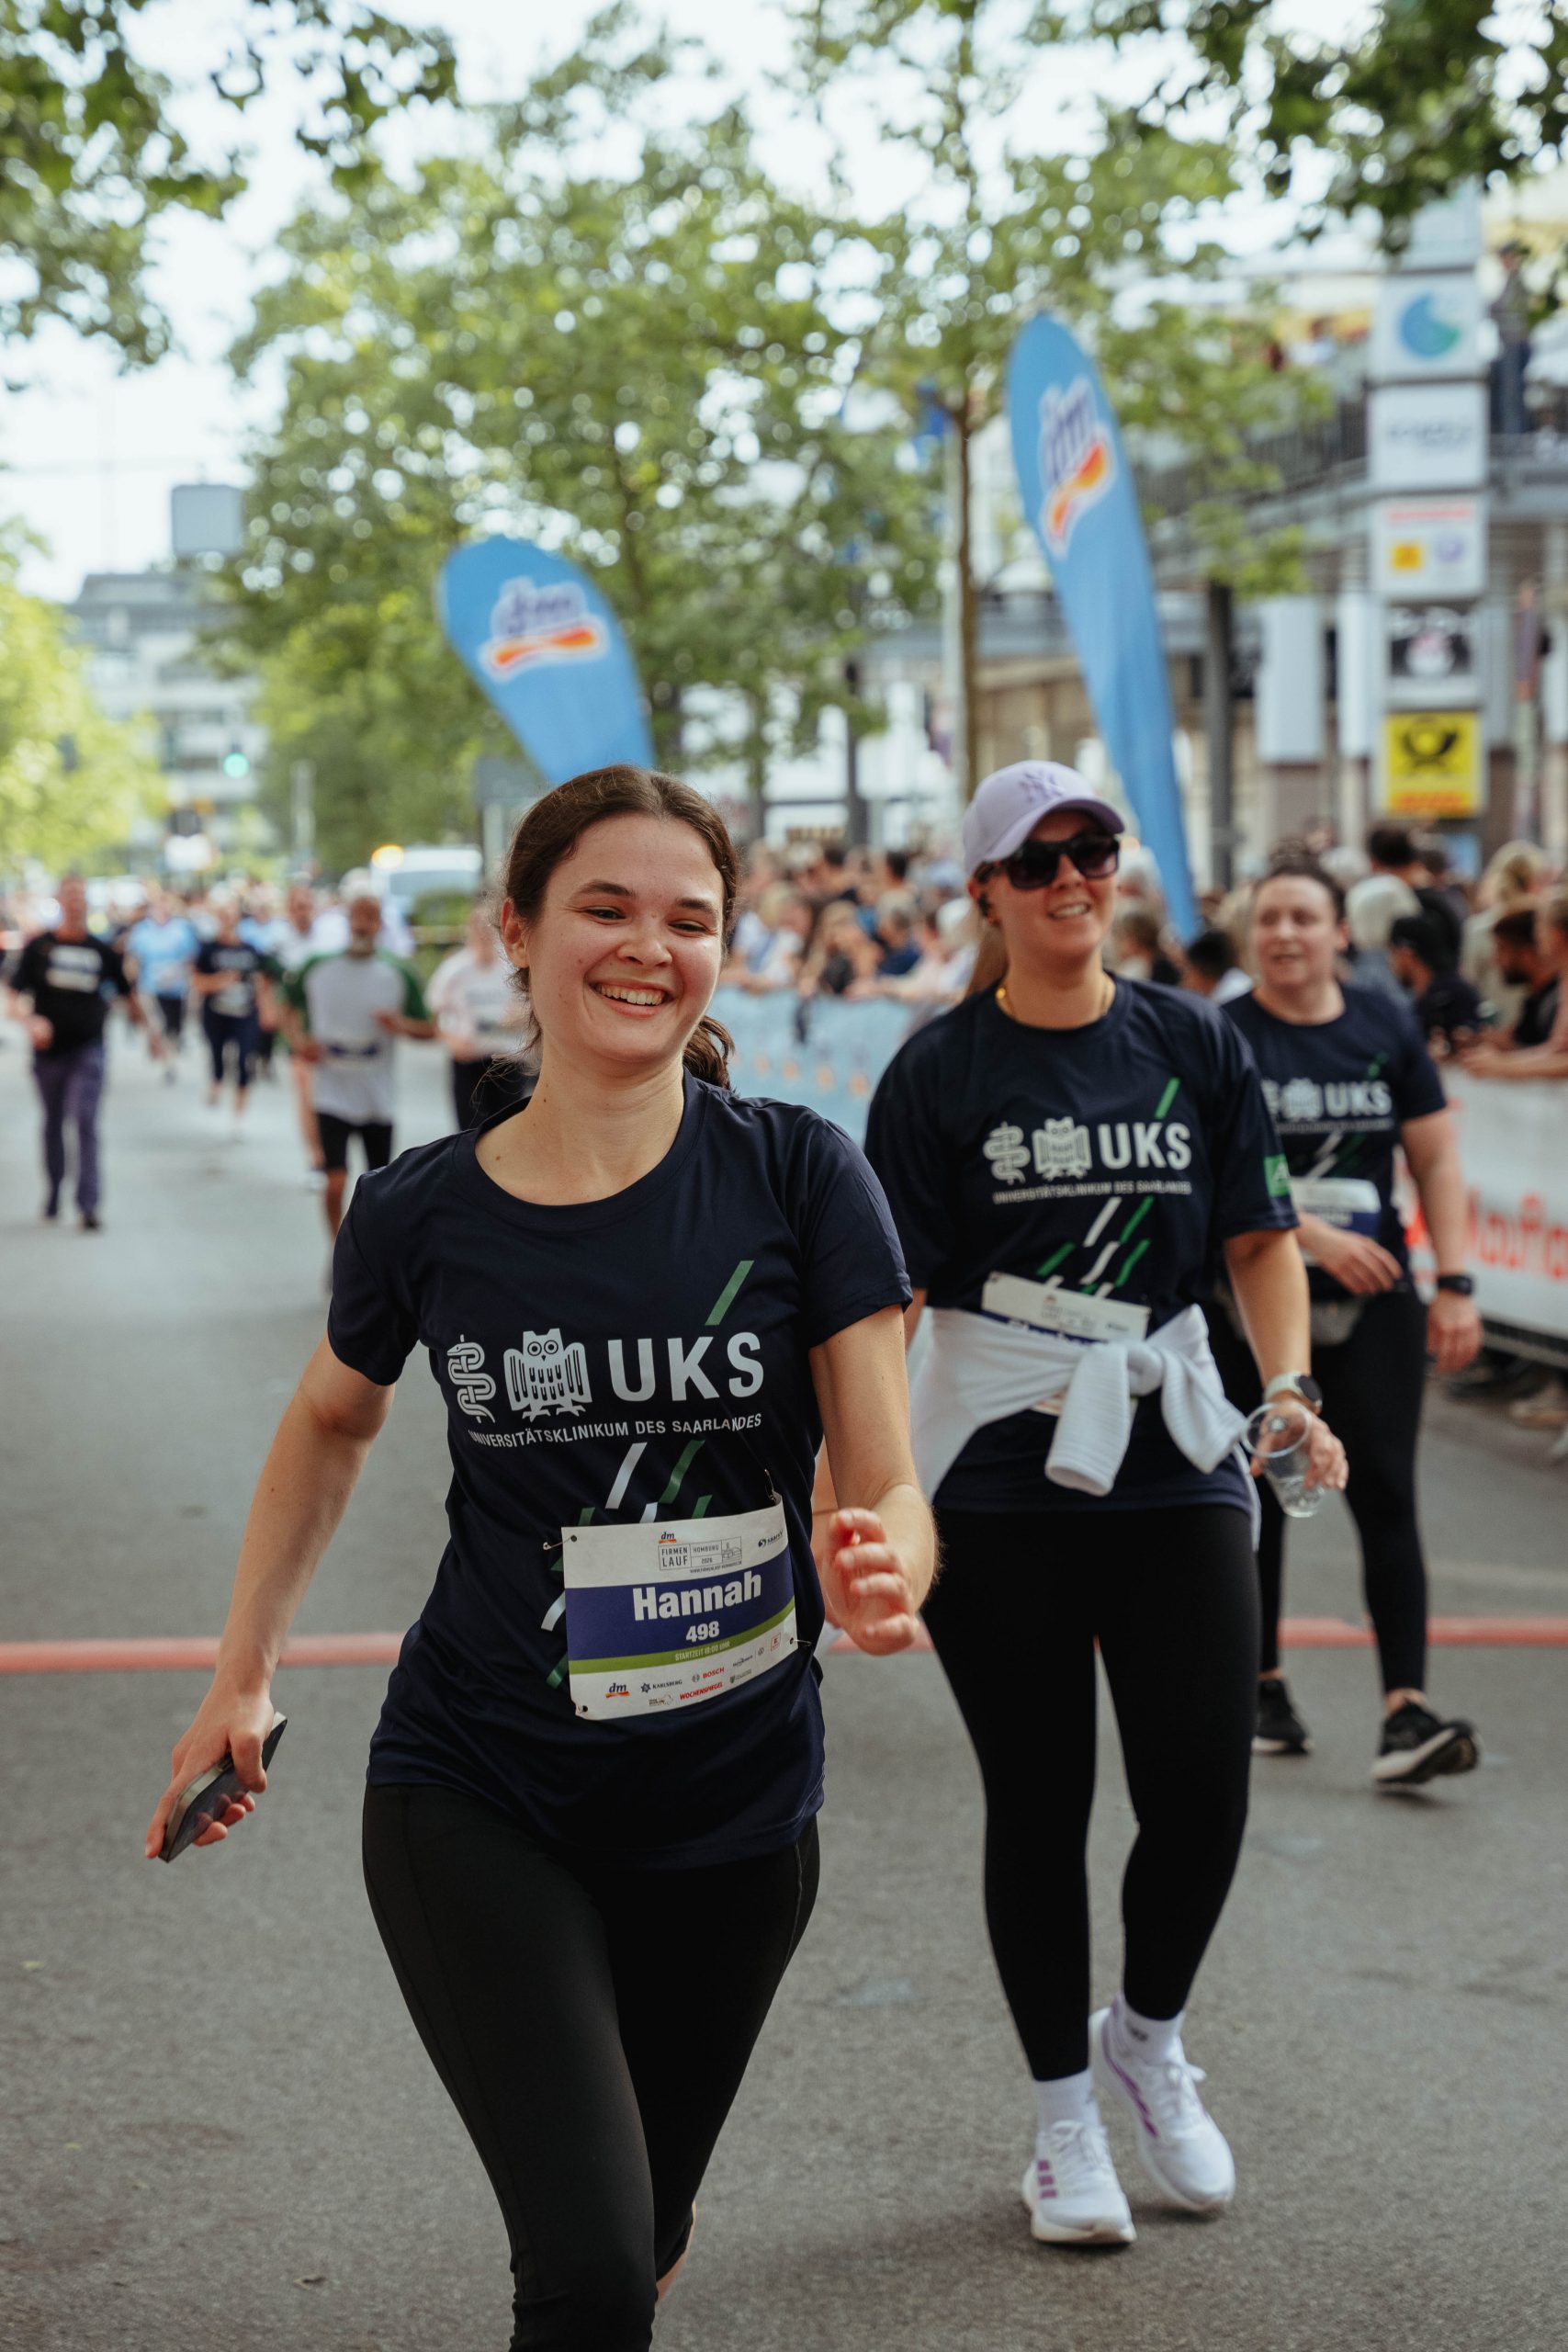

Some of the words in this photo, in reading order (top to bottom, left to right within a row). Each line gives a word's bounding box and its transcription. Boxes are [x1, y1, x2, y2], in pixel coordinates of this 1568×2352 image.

[1324, 1080, 1393, 1117] UKS
[1097, 1121, 1192, 1170] UKS
[607, 1331, 764, 1403] UKS
[468, 1421, 629, 1448] UNIVERSITÄTSKLINIKUM
[636, 1420, 667, 1435] DES
[672, 1413, 762, 1434] SAARLANDES
[660, 1532, 675, 1540] dm
[661, 1546, 688, 1556] FIRMEN
[662, 1555, 688, 1567] LAUF
[632, 1570, 762, 1622] Hannah
[685, 1620, 720, 1643] 498
[608, 1682, 627, 1693] dm
[652, 1679, 682, 1690] KARLSBERG
[702, 1666, 725, 1679] BOSCH
